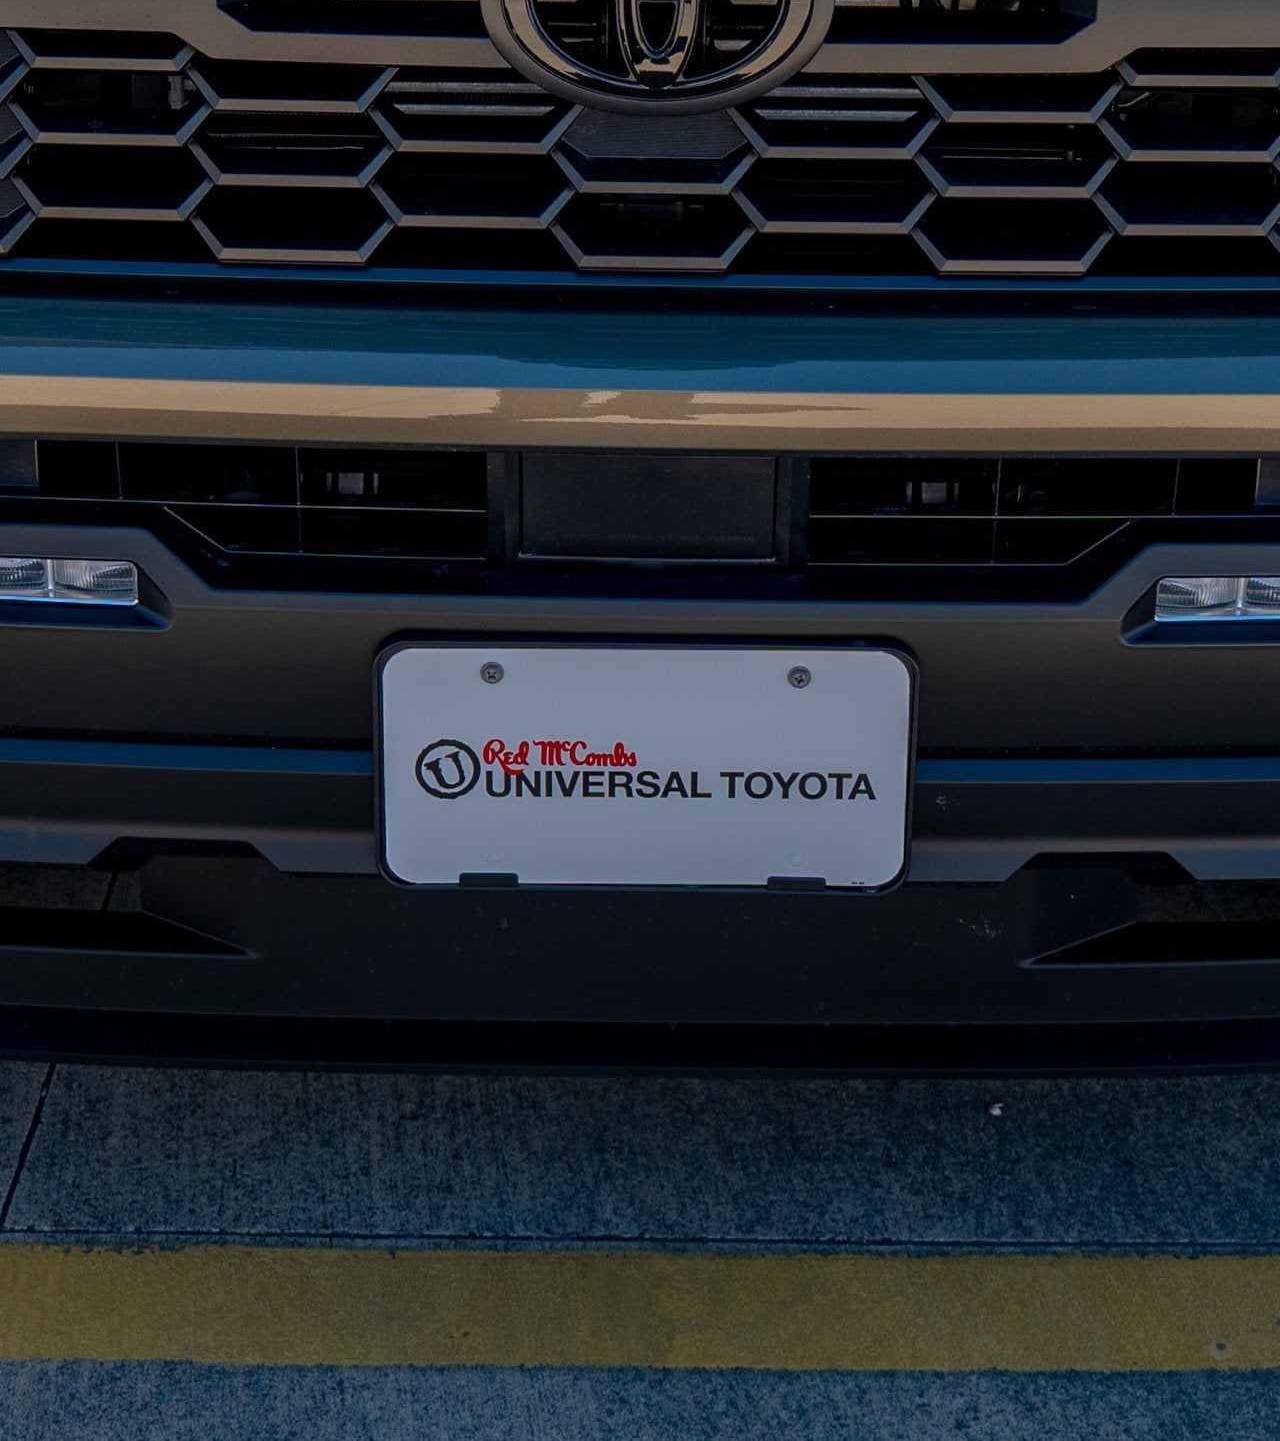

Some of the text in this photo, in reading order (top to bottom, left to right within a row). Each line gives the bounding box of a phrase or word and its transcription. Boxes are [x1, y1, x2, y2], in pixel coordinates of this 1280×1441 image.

[482, 739, 638, 775] Red McCombs
[485, 770, 876, 800] UNIVERSAL TOYOTA
